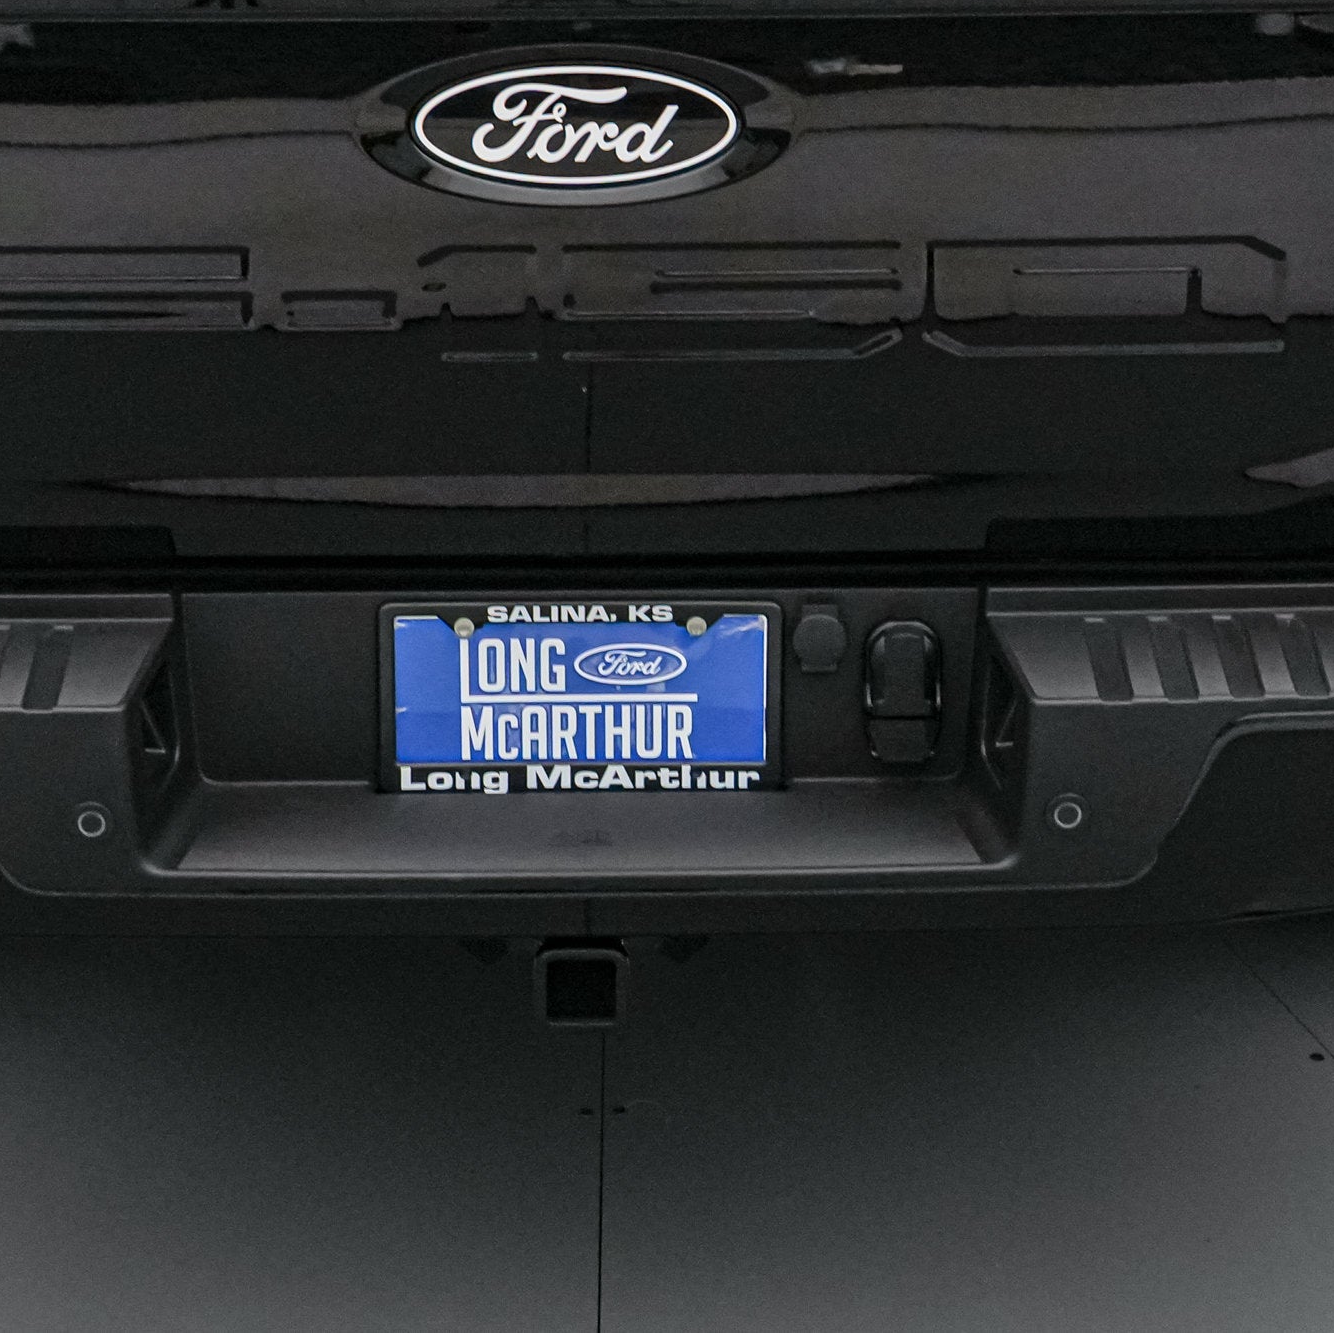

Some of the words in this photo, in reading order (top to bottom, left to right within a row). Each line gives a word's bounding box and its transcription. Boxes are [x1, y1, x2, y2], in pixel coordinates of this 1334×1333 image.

[471, 82, 679, 164] Ford
[486, 604, 617, 623] SALINA,
[628, 604, 674, 622] KS
[459, 637, 567, 696] LONG
[597, 649, 662, 676] Ford
[461, 703, 694, 760] McARTHUR
[400, 765, 510, 795] Long
[525, 764, 761, 790] McArthur
